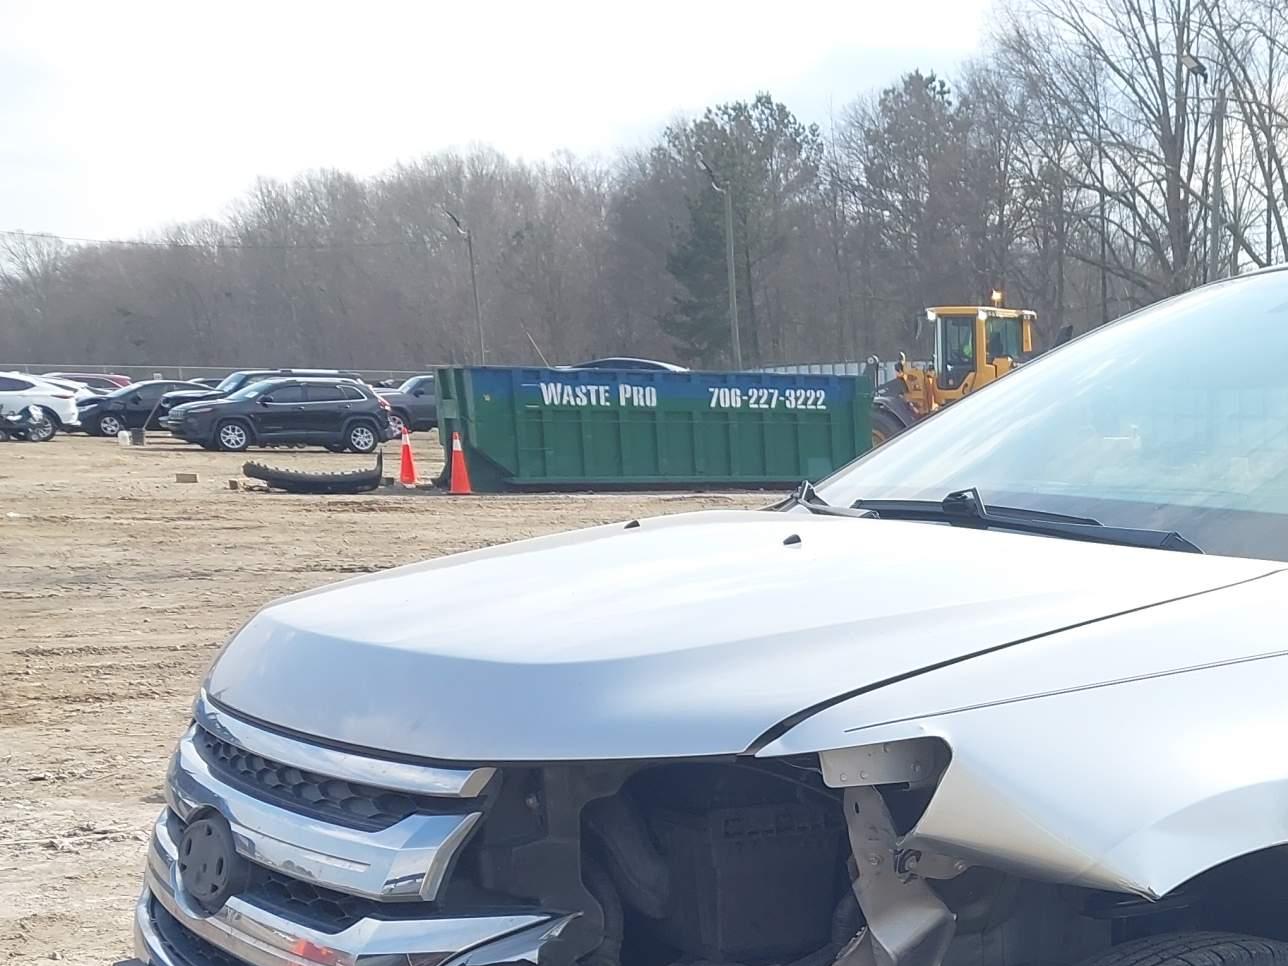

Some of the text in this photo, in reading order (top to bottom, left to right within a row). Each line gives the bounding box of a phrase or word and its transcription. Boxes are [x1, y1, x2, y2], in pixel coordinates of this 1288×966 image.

[539, 382, 658, 407] WASTE PRO
[707, 387, 827, 411] 706-227-3222
